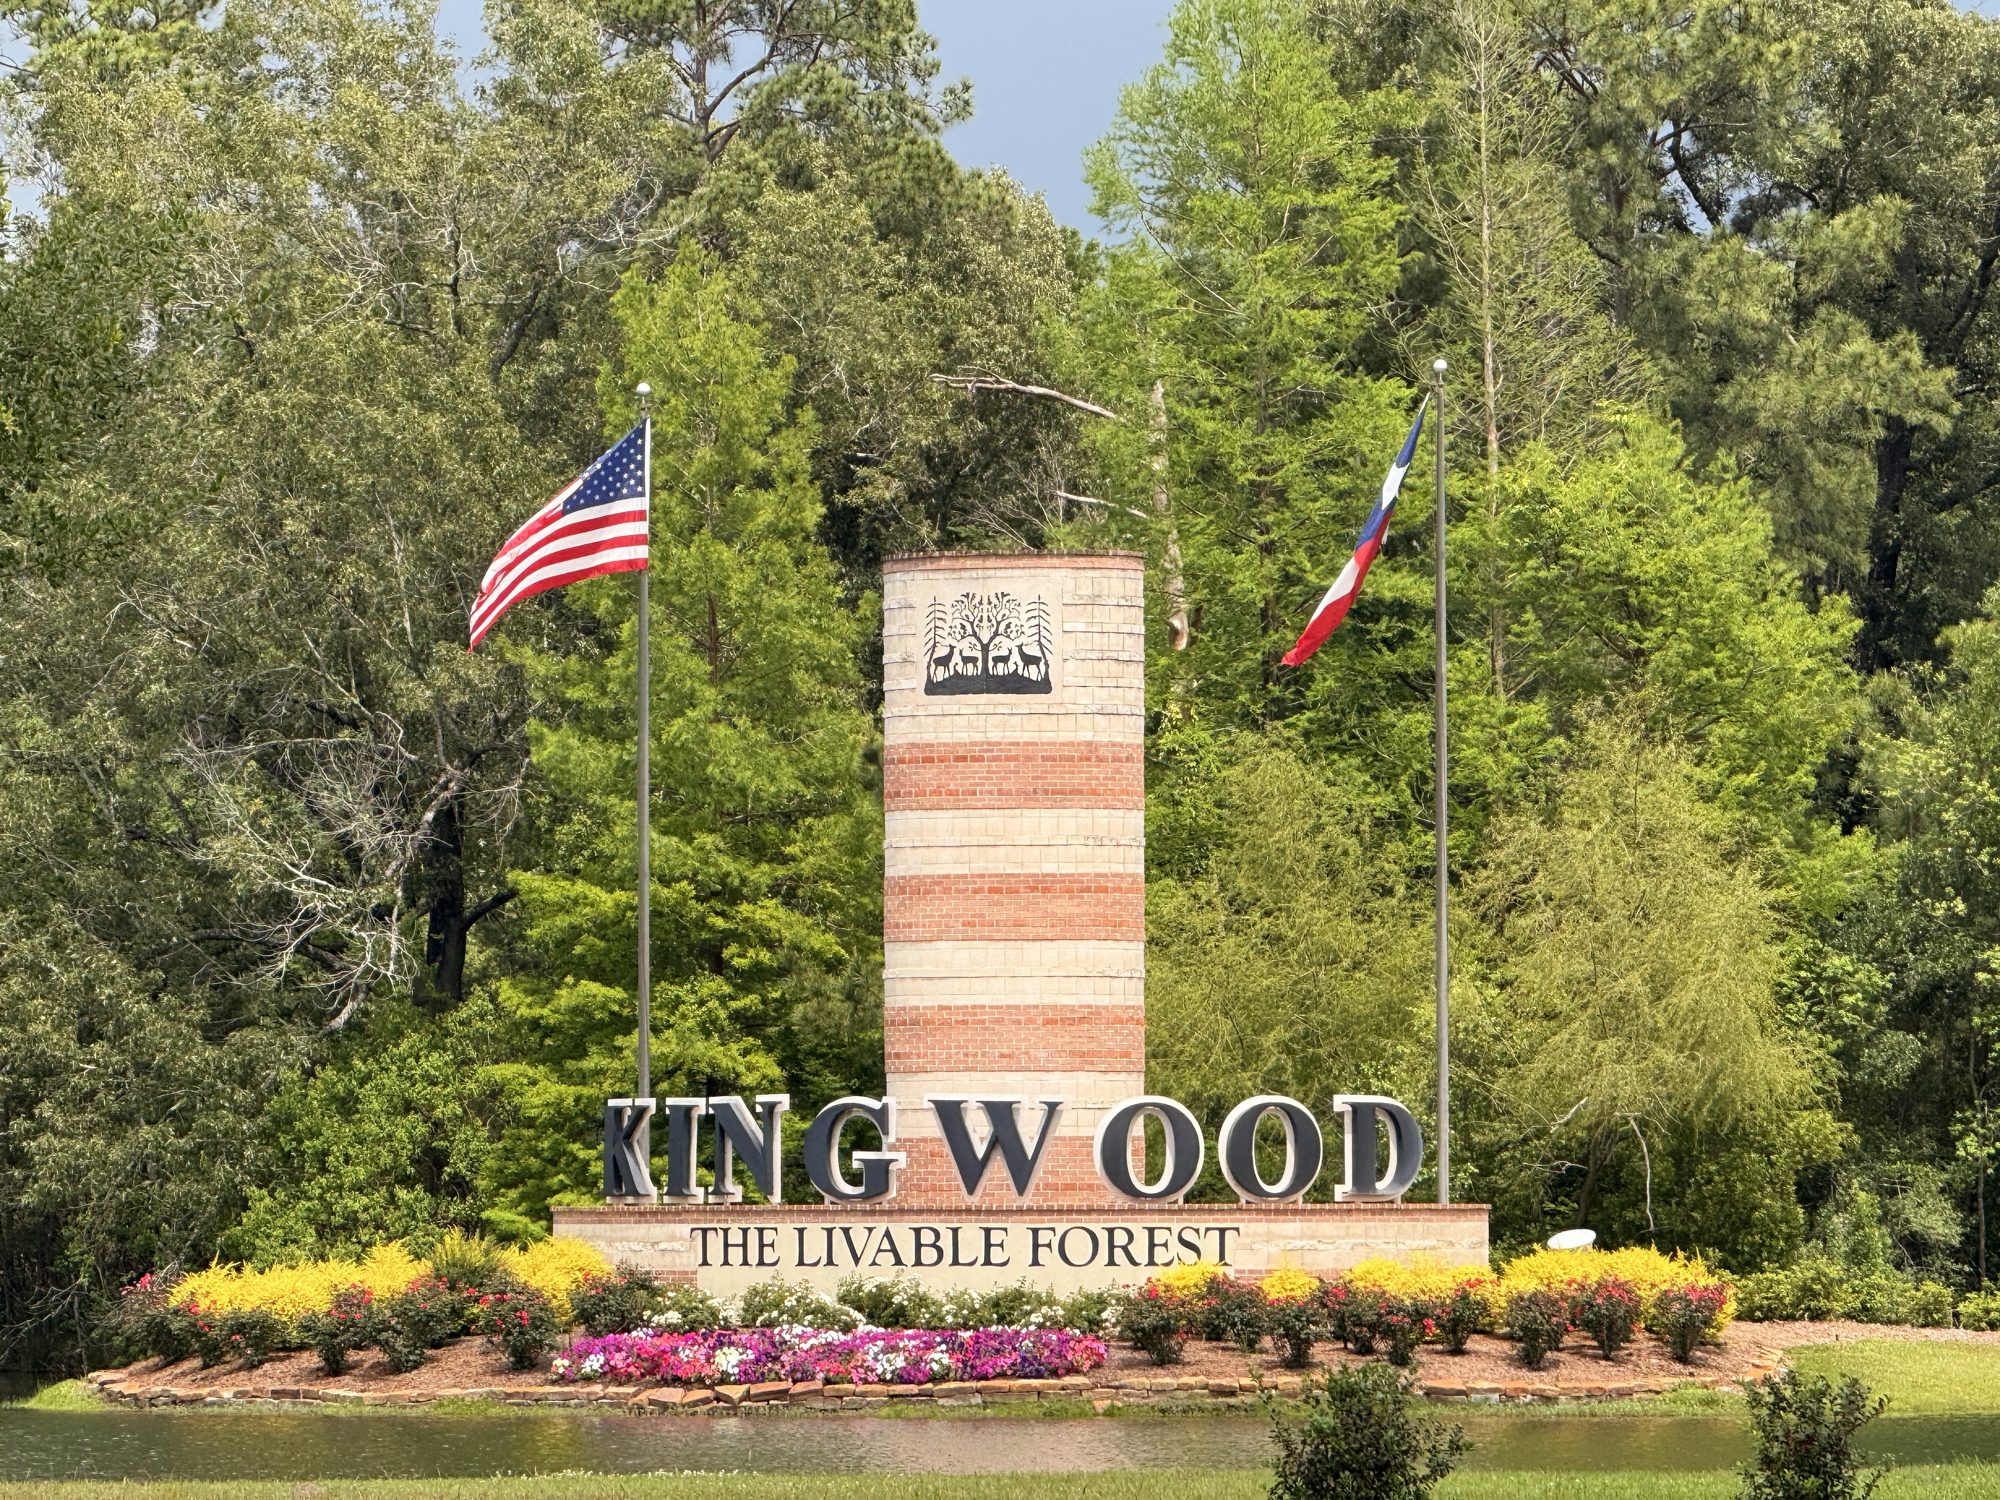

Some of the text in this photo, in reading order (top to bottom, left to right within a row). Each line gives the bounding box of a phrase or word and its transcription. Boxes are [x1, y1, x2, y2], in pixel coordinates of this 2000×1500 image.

[603, 1094, 1424, 1203] KINGWOOD
[690, 1225, 1240, 1267] THE LIVABLE FOREST
